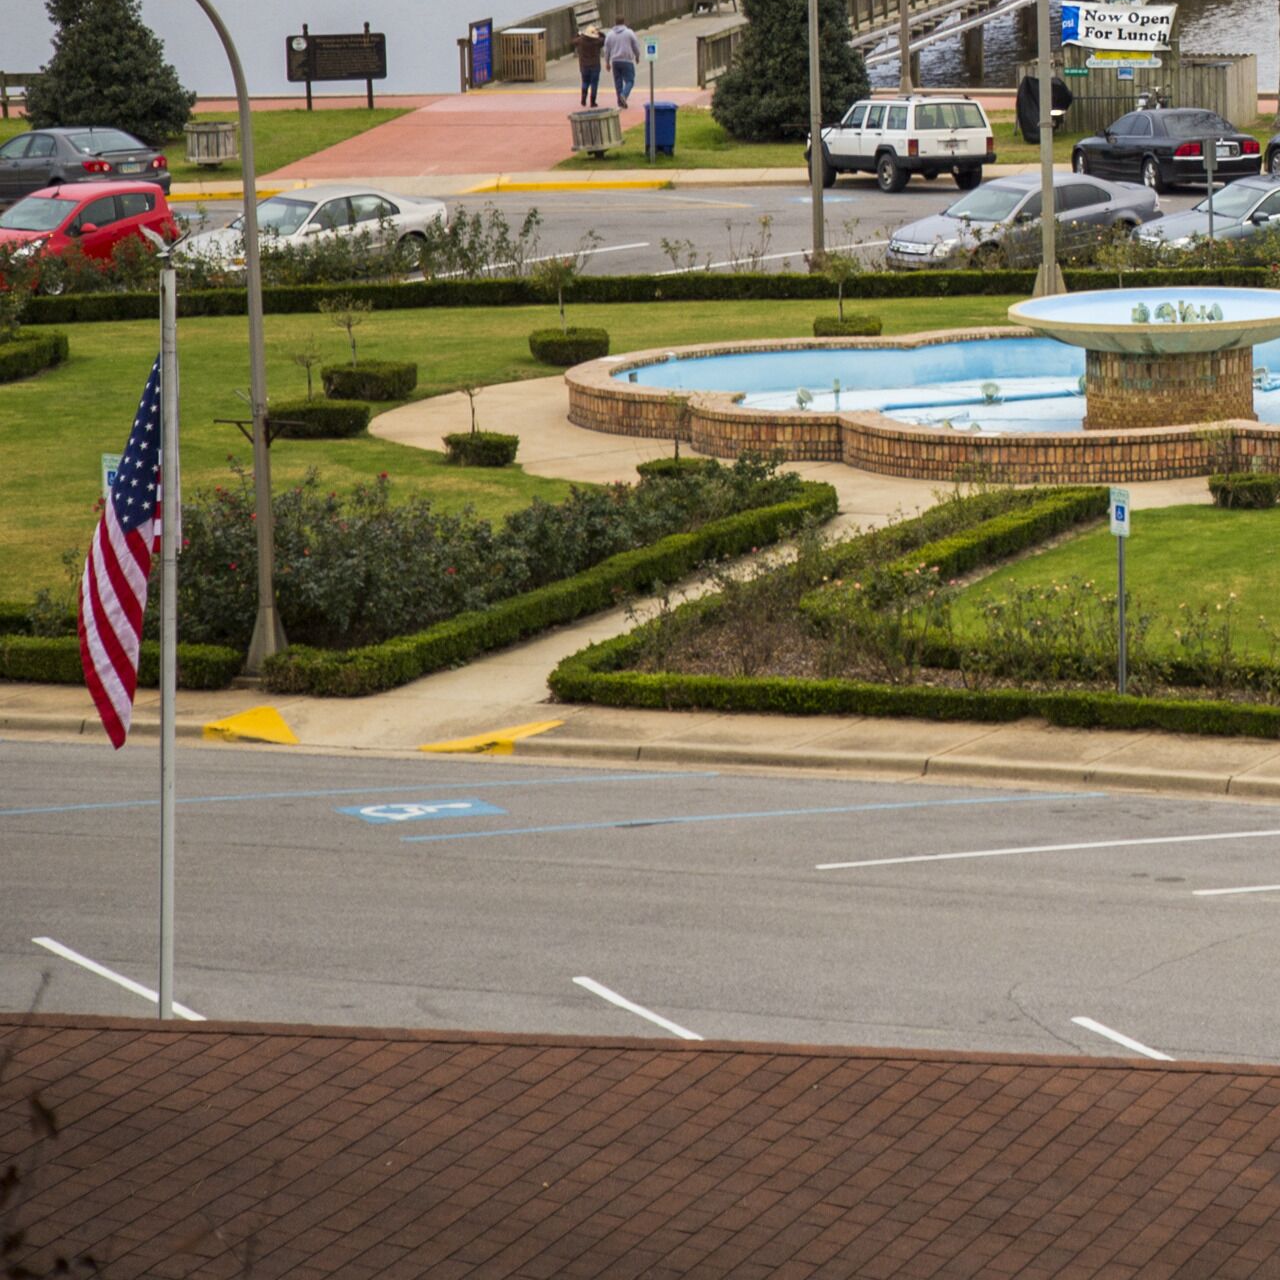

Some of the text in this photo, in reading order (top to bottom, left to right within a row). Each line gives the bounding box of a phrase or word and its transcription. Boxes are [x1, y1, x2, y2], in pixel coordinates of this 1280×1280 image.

[1085, 9, 1170, 26] Now Open
[1085, 26, 1169, 47] For Lunch
